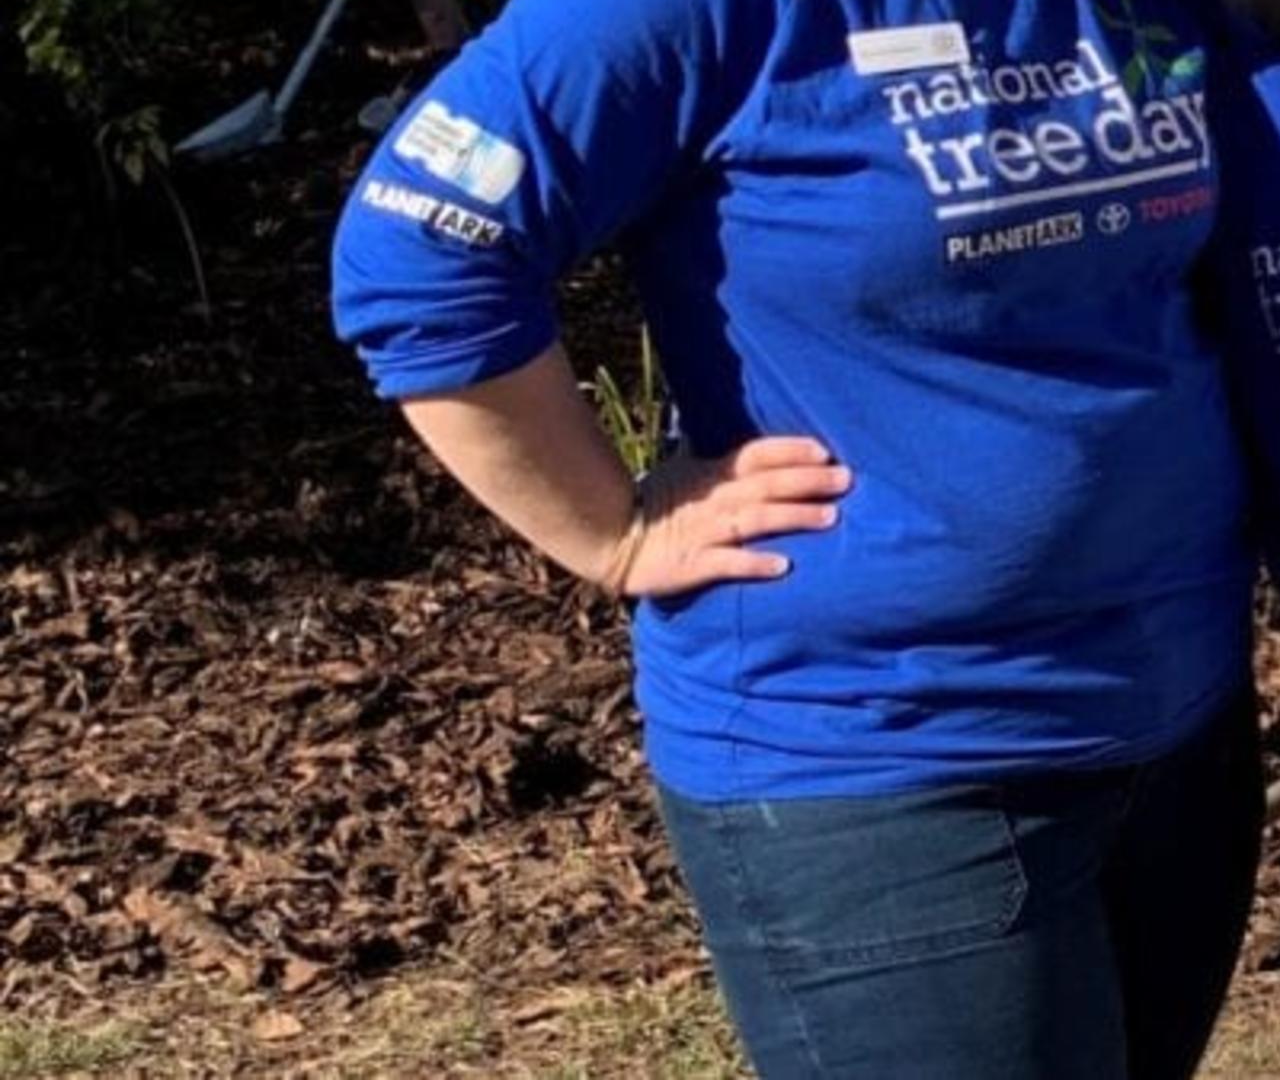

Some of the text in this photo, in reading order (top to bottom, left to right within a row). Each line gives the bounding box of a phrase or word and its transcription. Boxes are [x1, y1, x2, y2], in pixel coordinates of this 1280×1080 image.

[882, 39, 1119, 125] national
[903, 83, 1212, 195] tree day
